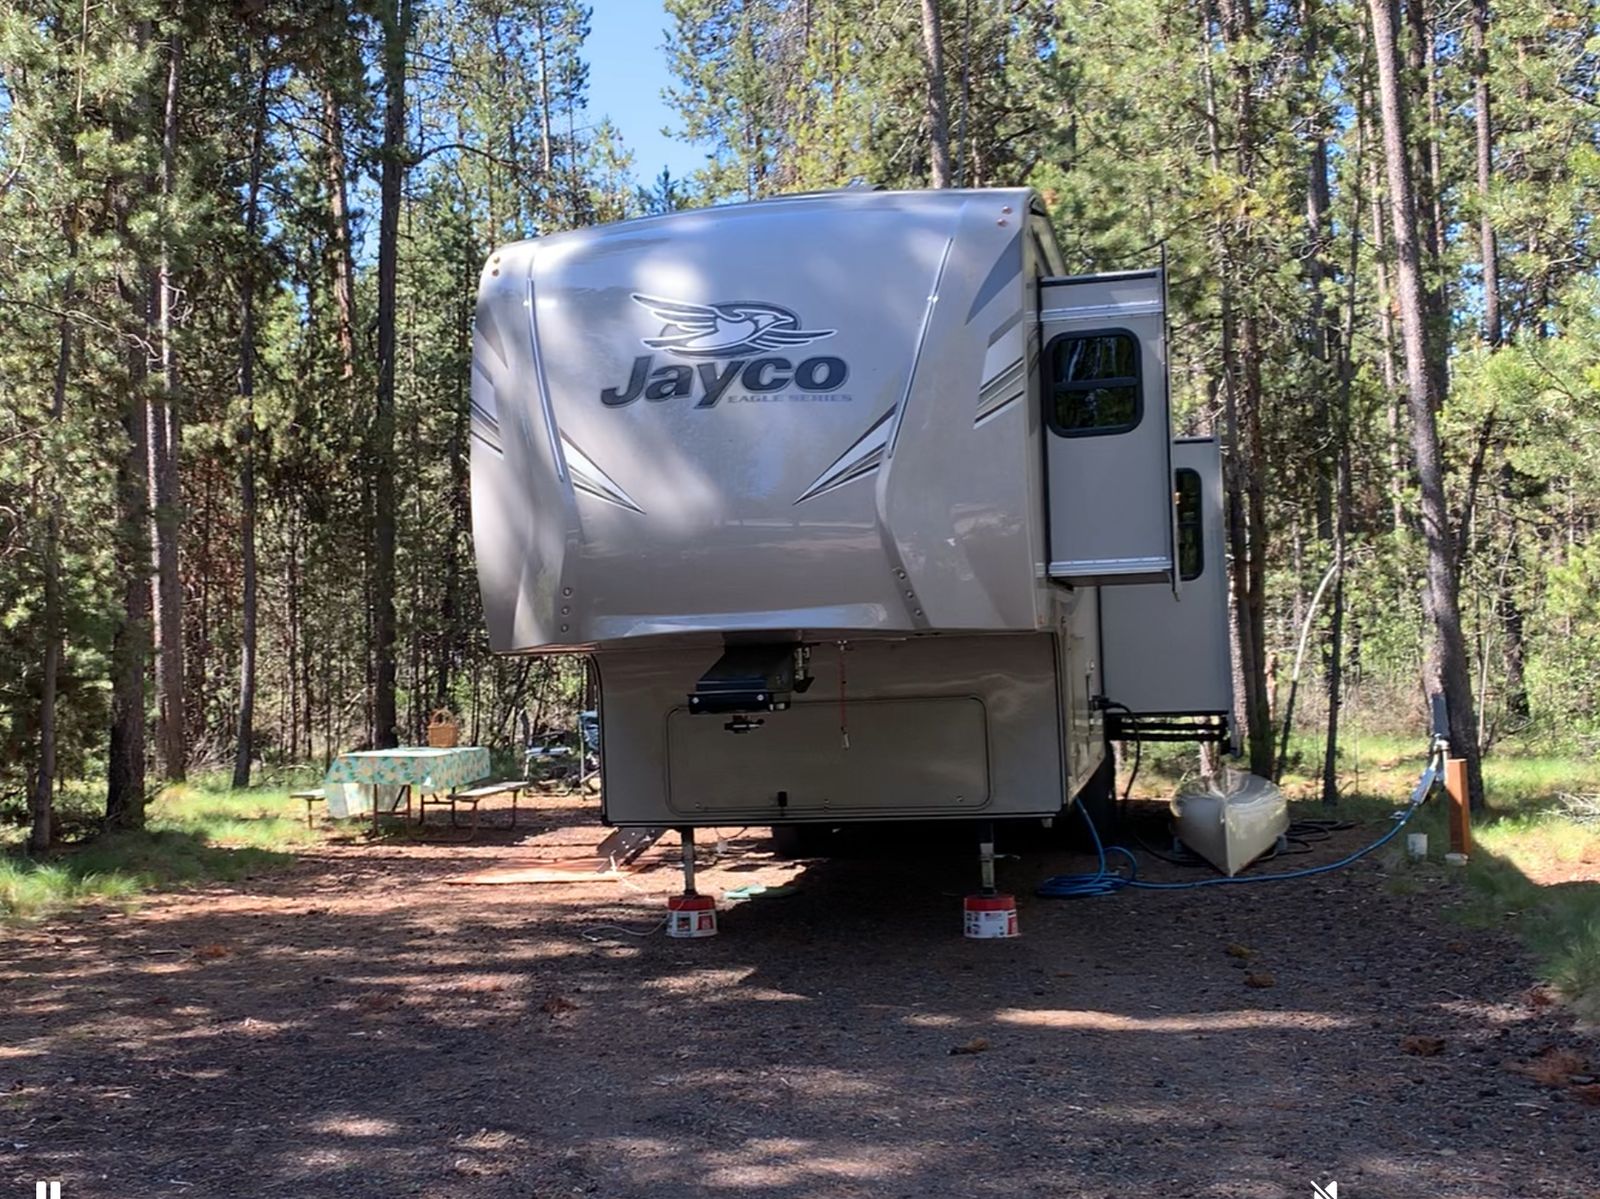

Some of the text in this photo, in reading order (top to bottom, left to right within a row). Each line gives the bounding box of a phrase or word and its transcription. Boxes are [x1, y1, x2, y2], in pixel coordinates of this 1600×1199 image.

[601, 355, 849, 410] Jayco
[727, 393, 853, 404] EAGLE SERIES
